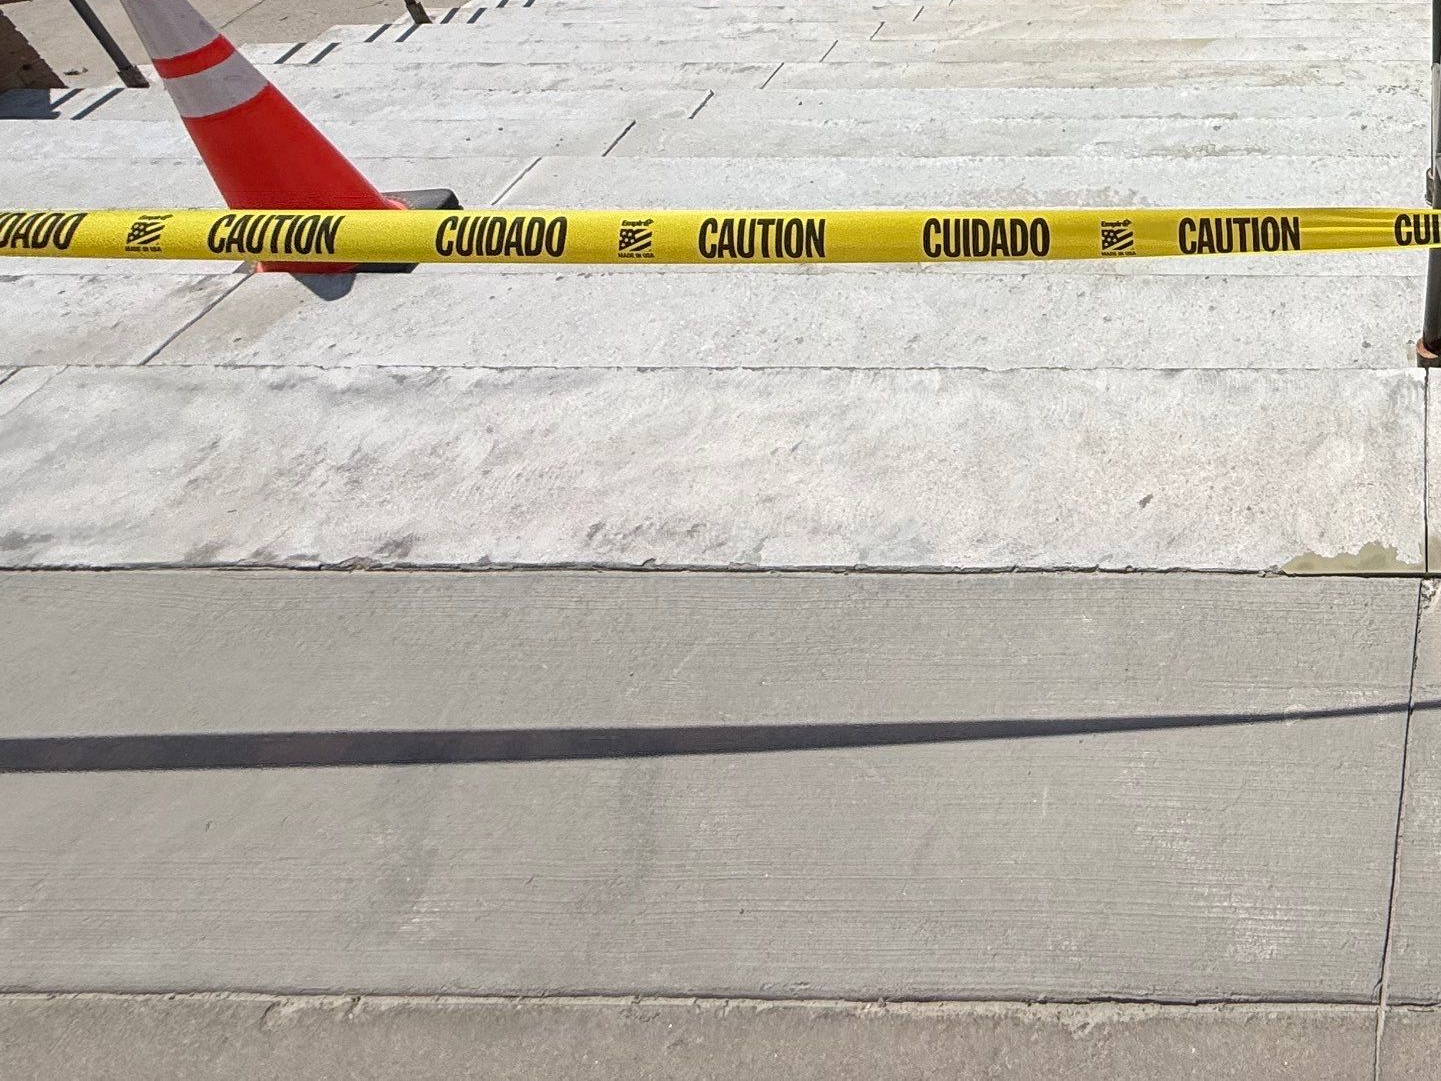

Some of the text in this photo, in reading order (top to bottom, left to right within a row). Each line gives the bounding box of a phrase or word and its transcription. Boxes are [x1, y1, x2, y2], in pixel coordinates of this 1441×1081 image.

[0, 213, 88, 250] DADO
[208, 214, 345, 255] CAUTION
[436, 216, 567, 257] CUIDADO
[700, 218, 826, 259] CAUTION
[922, 218, 1050, 258] CUIDADO
[1178, 216, 1300, 254] CAUTION
